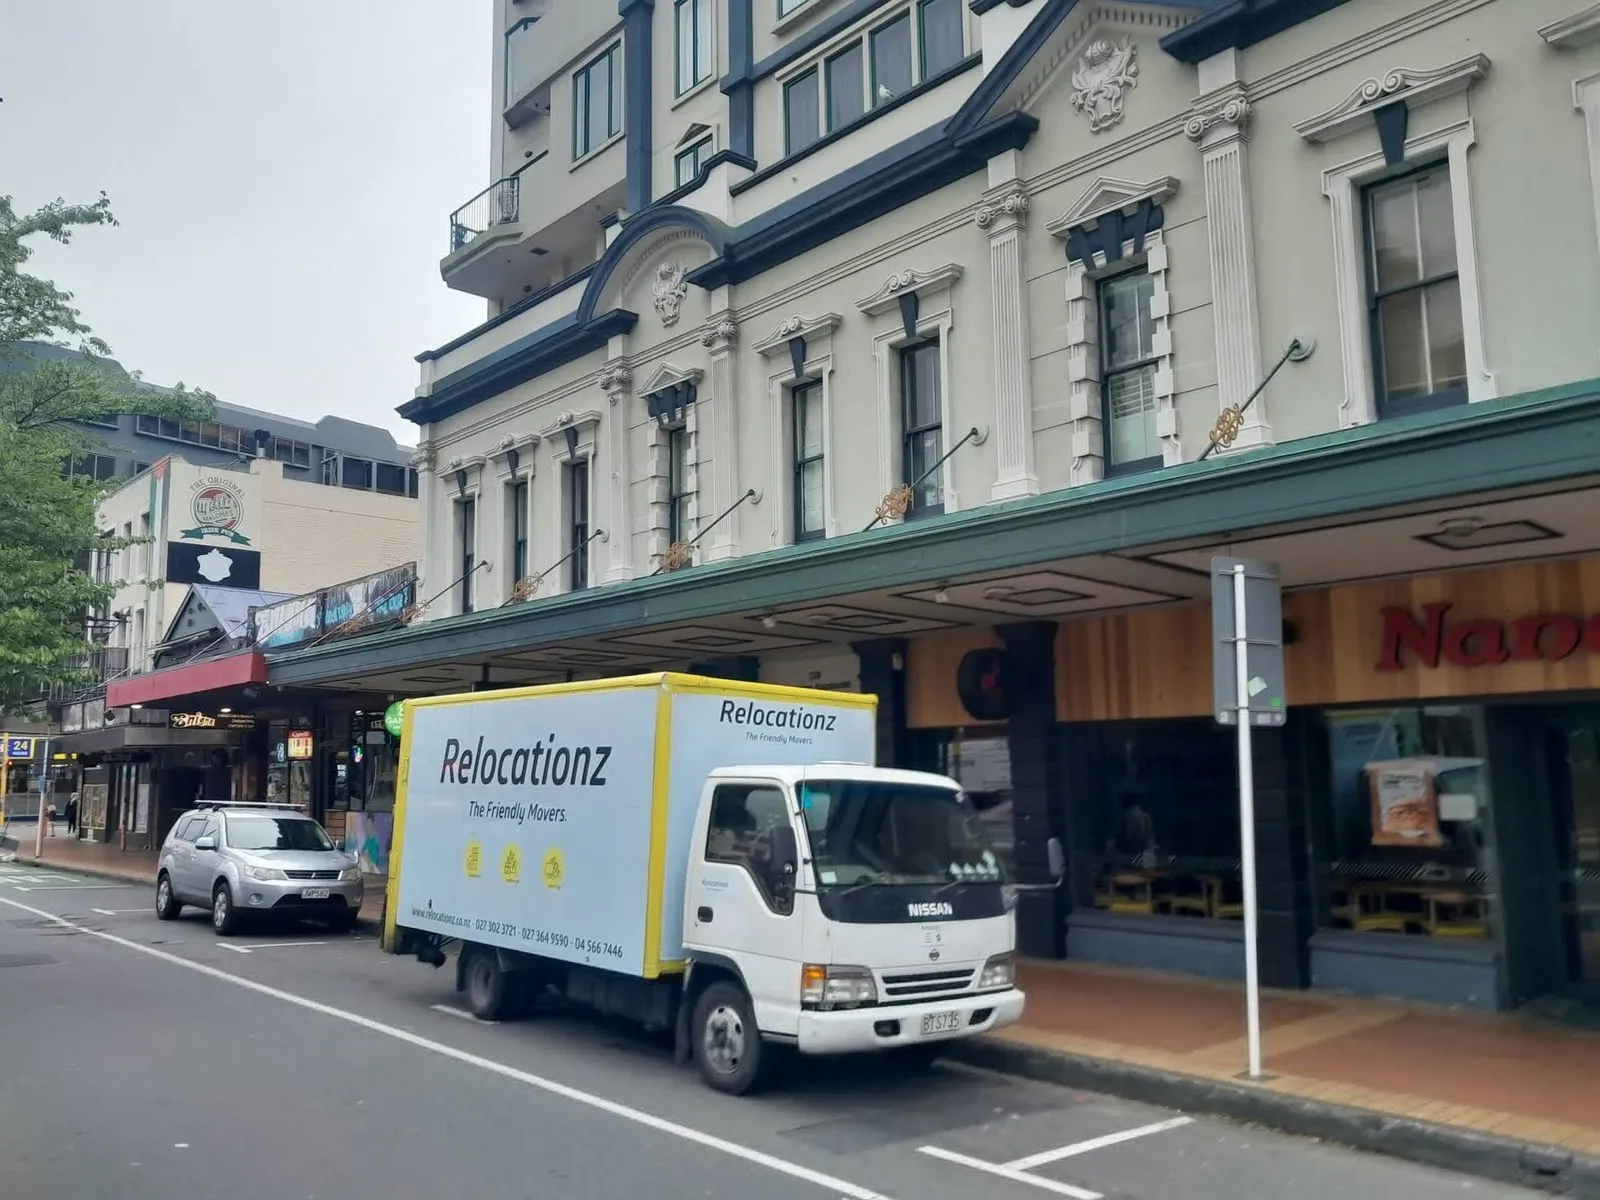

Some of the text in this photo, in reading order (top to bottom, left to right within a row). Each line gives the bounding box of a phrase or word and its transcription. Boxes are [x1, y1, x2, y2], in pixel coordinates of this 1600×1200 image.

[190, 477, 246, 499] THE ORIGINAL
[221, 529, 234, 537] PUB
[1374, 602, 1600, 674] Nan
[720, 700, 837, 731] Relocationz
[13, 740, 28, 751] 24
[745, 732, 813, 745] The Friendly Movers
[440, 733, 612, 786] Relocationz
[469, 801, 568, 825] The Friendly Movers.
[908, 902, 953, 917] NISSAN
[412, 907, 471, 927] www.relocationz.co.nz
[475, 919, 487, 931] 027
[488, 921, 500, 934] 302
[502, 923, 517, 937] 3721
[522, 927, 536, 941] 027
[536, 930, 550, 944] 364
[551, 933, 569, 948] 9590
[575, 940, 586, 952] 04
[587, 942, 601, 955] 566
[603, 944, 623, 958] 7446
